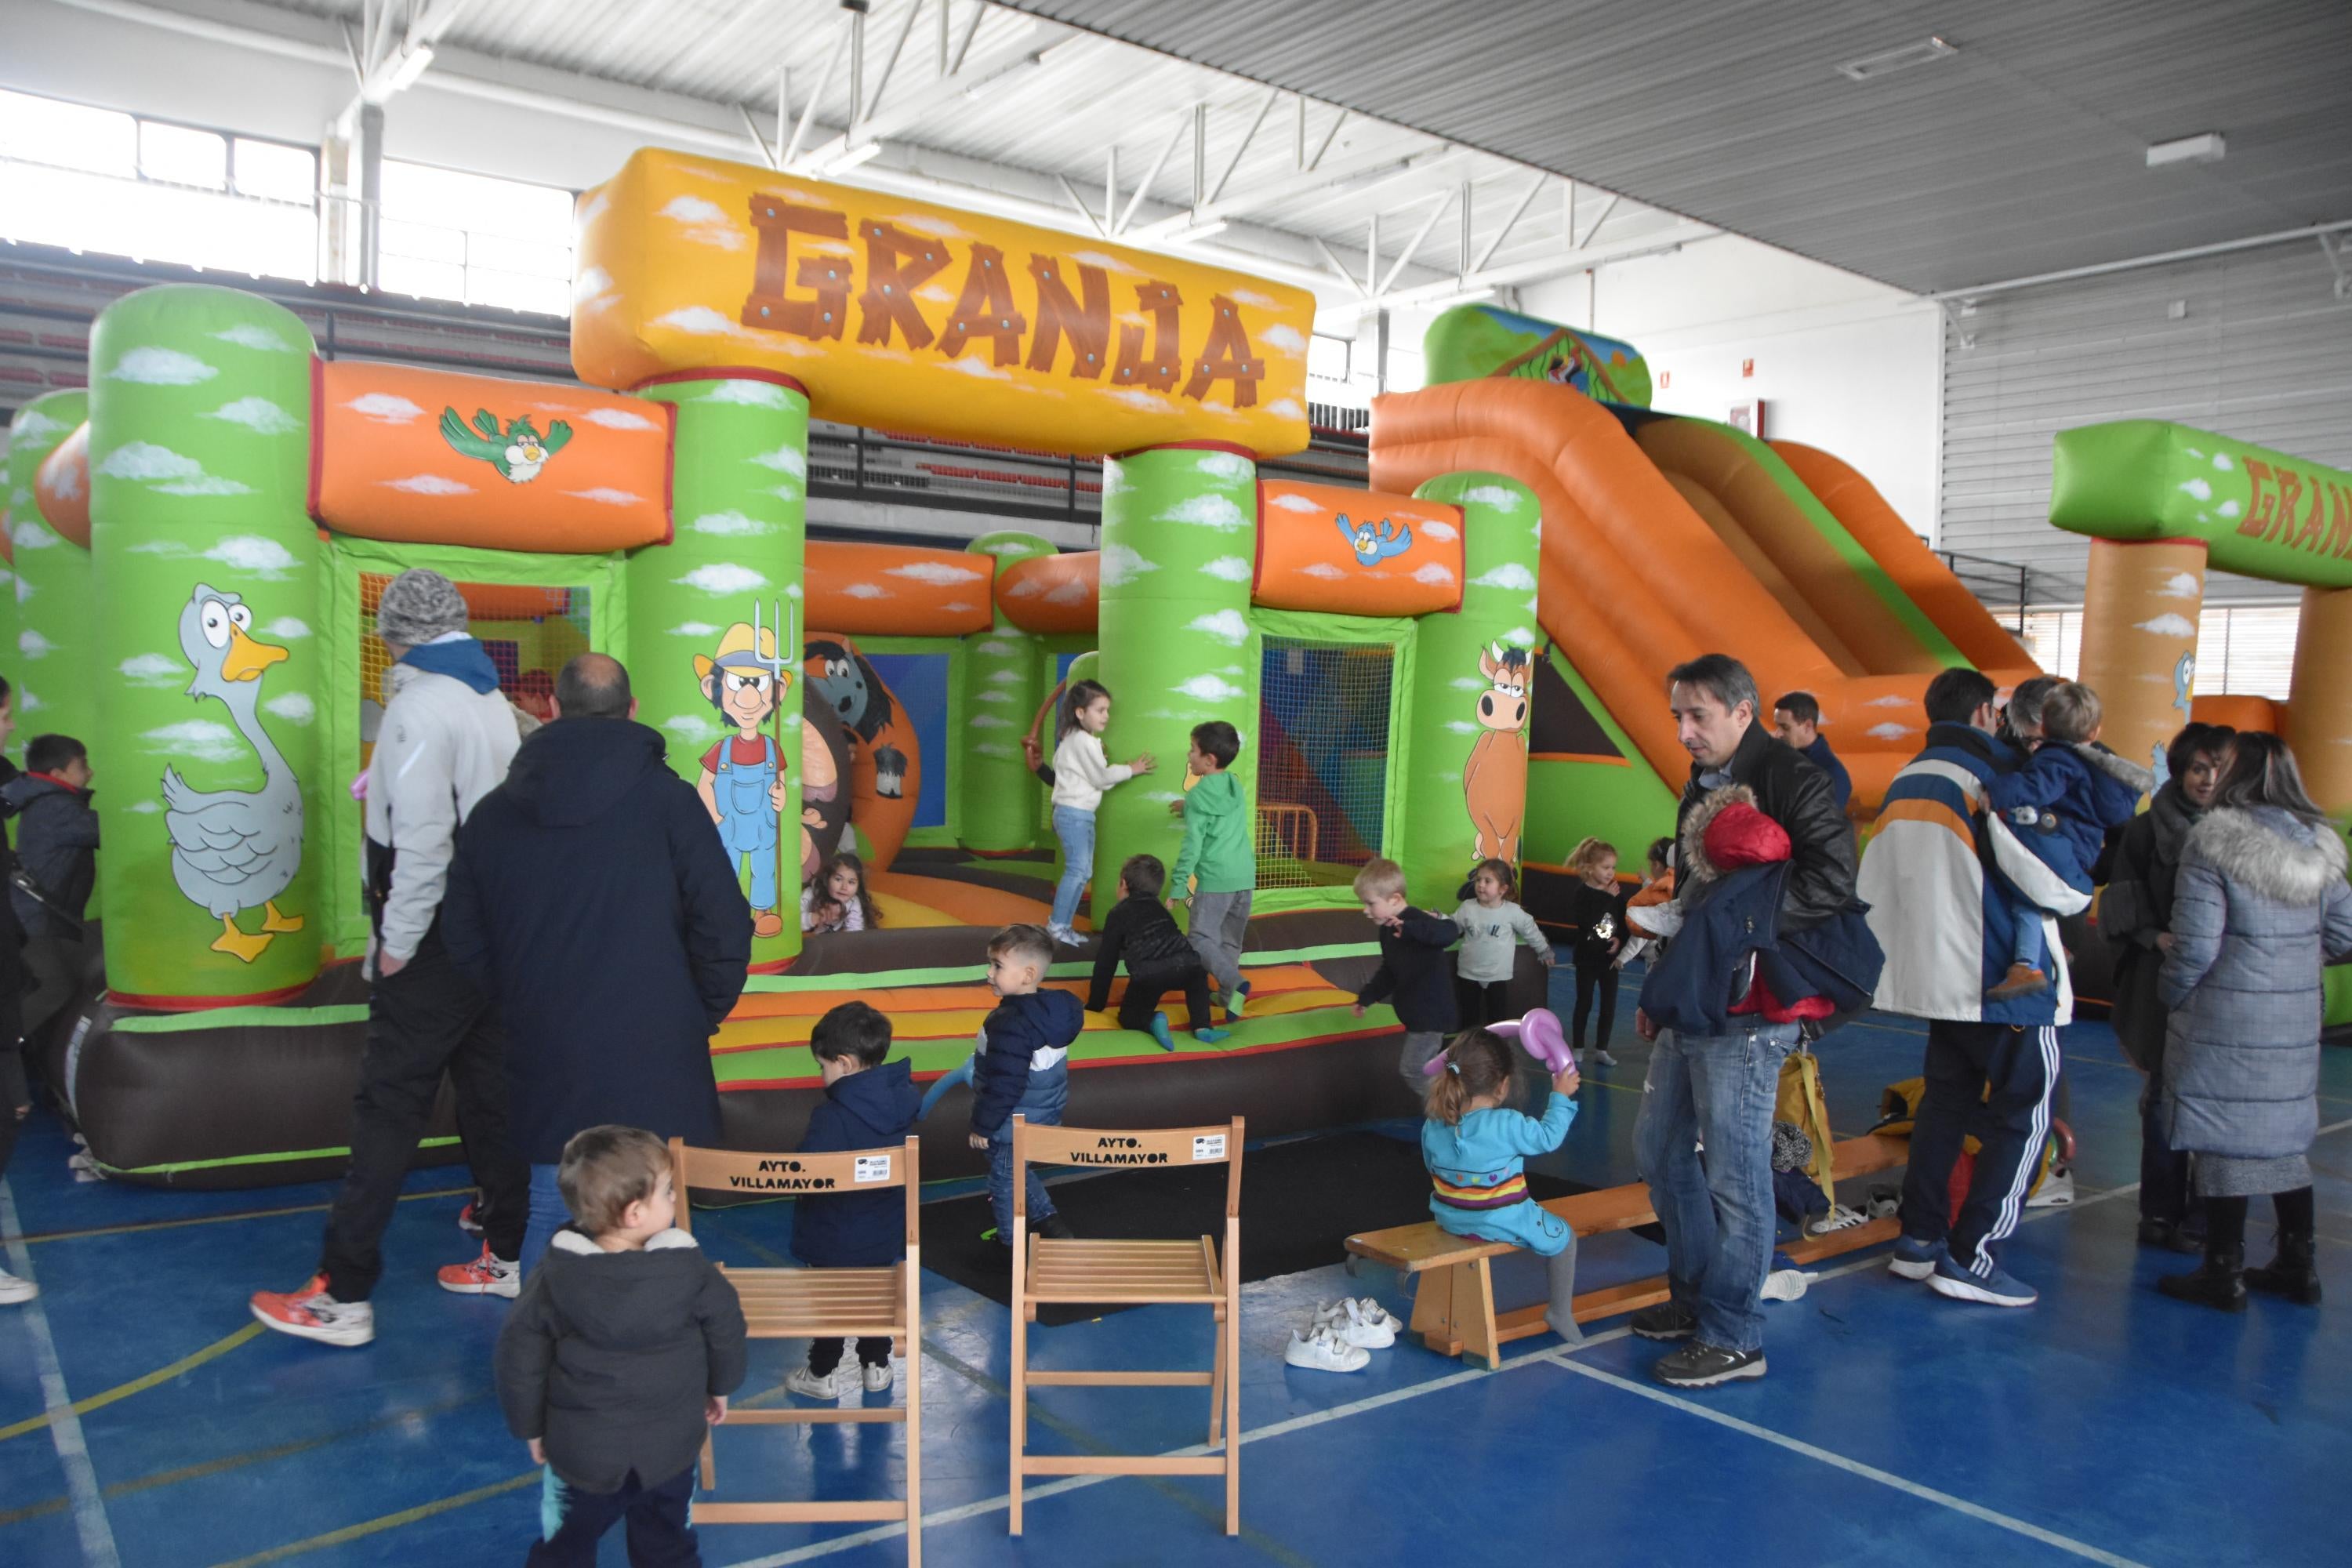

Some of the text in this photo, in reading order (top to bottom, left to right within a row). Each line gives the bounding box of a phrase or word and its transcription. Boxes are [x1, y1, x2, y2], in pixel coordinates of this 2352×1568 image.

[741, 192, 1265, 408] GRANJA
[2236, 455, 2352, 561] GRAN
[1098, 1137, 1142, 1149] AYTO.
[1071, 1152, 1167, 1164] VILLAMAYOR
[758, 1160, 806, 1173] AYTO.
[729, 1176, 835, 1189] VILLAMAYOR
